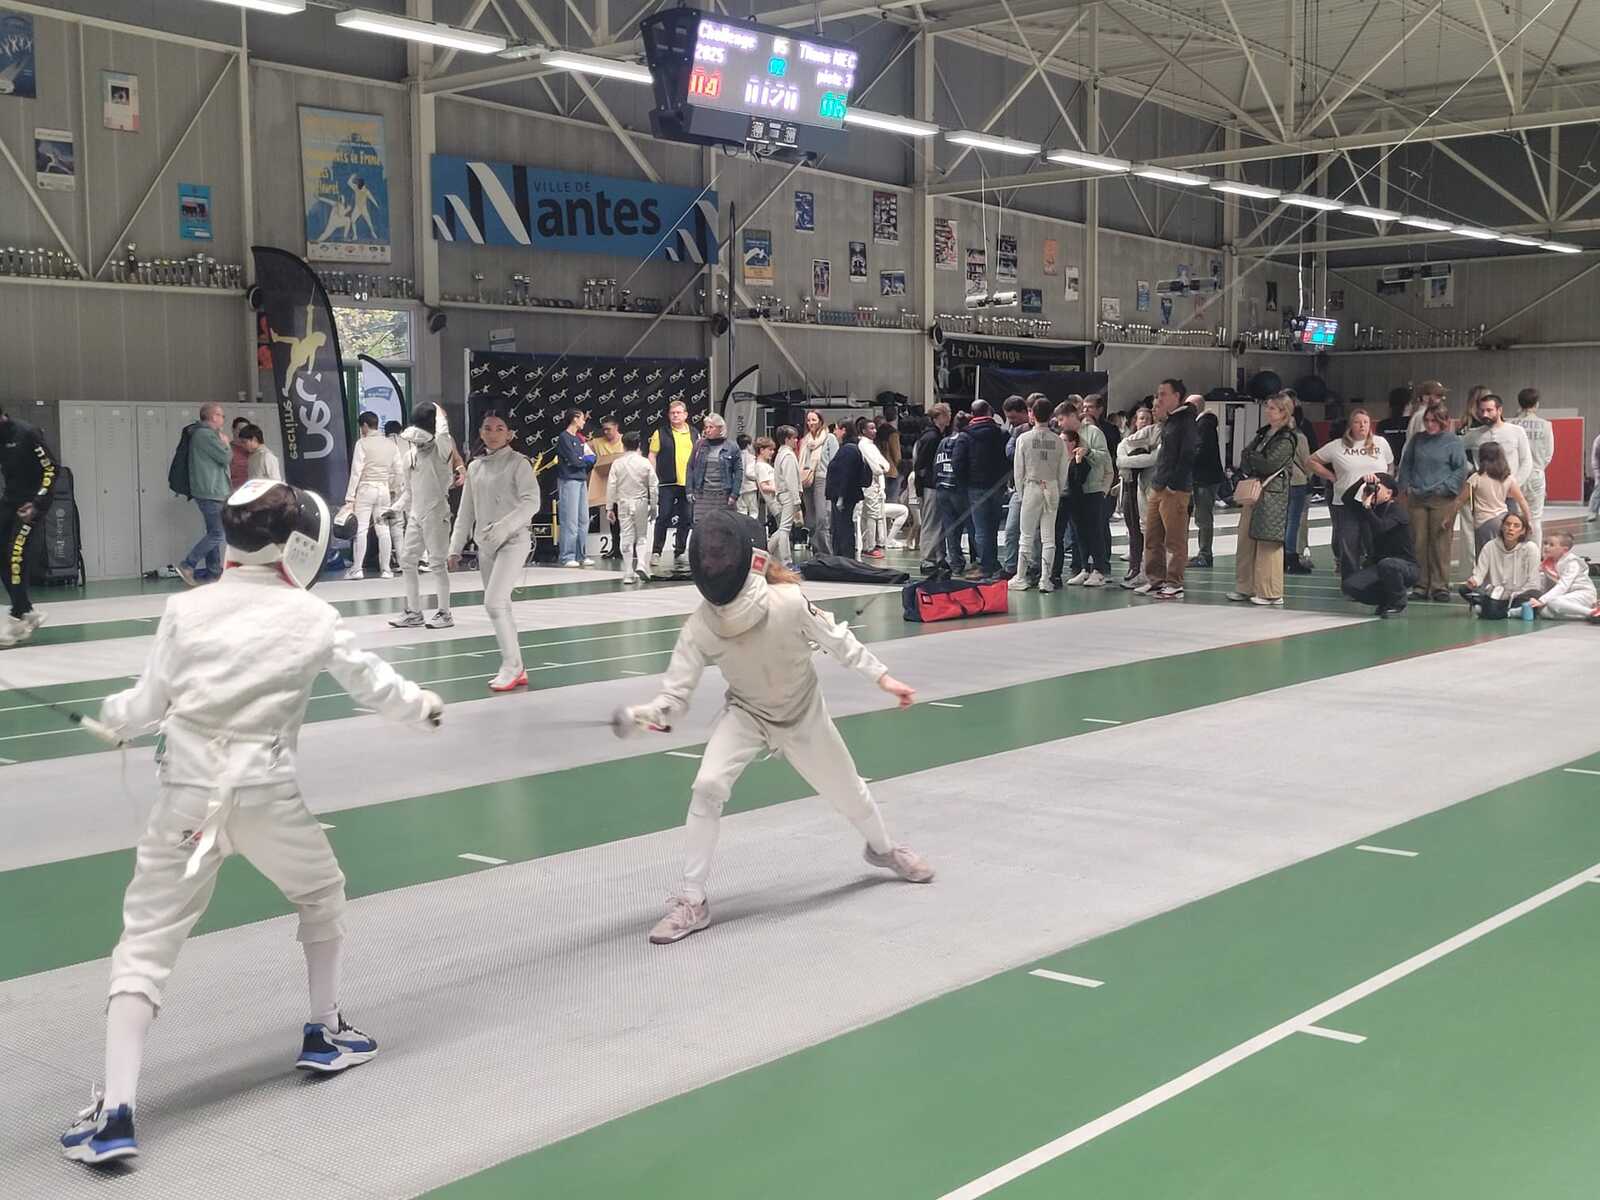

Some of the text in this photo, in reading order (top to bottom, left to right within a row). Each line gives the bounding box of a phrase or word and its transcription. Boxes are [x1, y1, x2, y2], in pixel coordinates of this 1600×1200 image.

[699, 20, 757, 50] Challenge
[533, 181, 592, 194] VILLE DE
[1344, 447, 1381, 456] AMOR
[600, 536, 609, 553] 2
[11, 524, 32, 585] nantes
